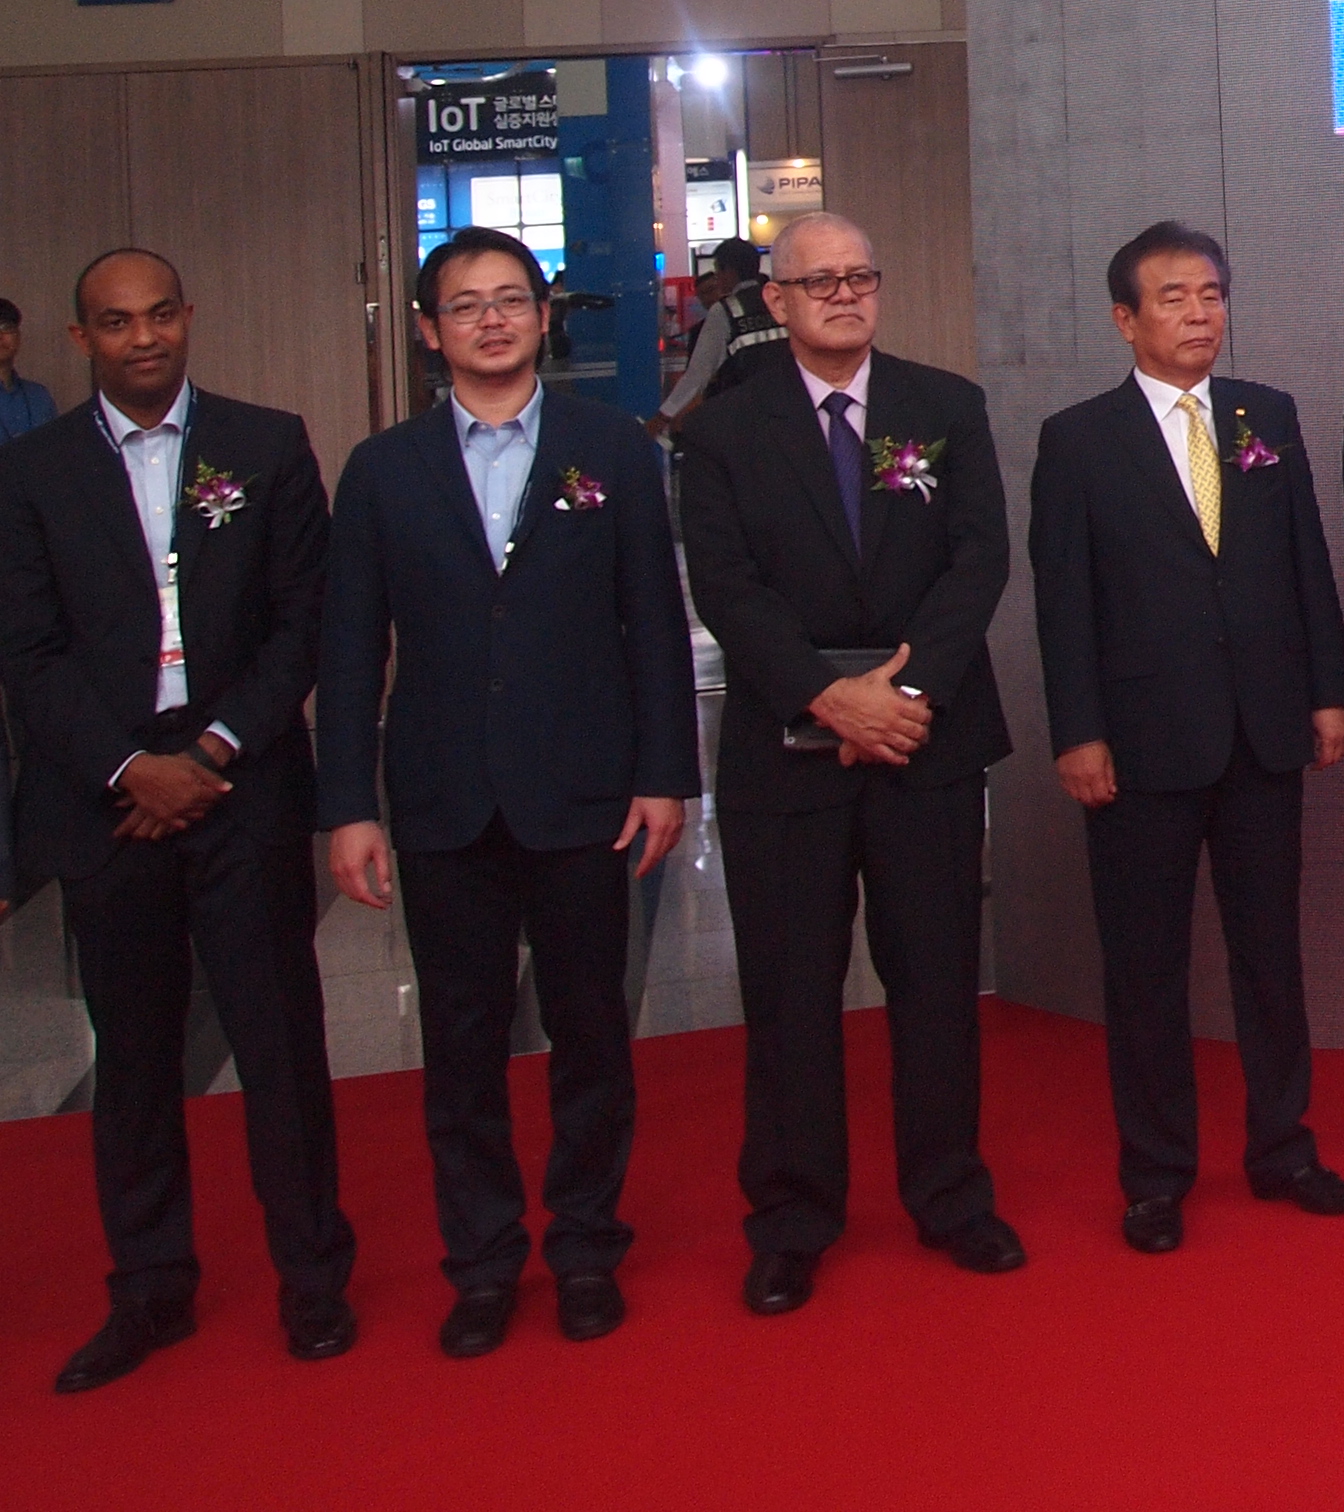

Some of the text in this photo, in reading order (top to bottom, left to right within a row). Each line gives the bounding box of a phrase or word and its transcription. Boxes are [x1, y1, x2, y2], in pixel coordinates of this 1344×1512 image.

[428, 96, 486, 133] IoT
[493, 95, 537, 112] 글로벌
[430, 135, 558, 155] IoT Global SmartCity
[778, 176, 822, 189] PIPA
